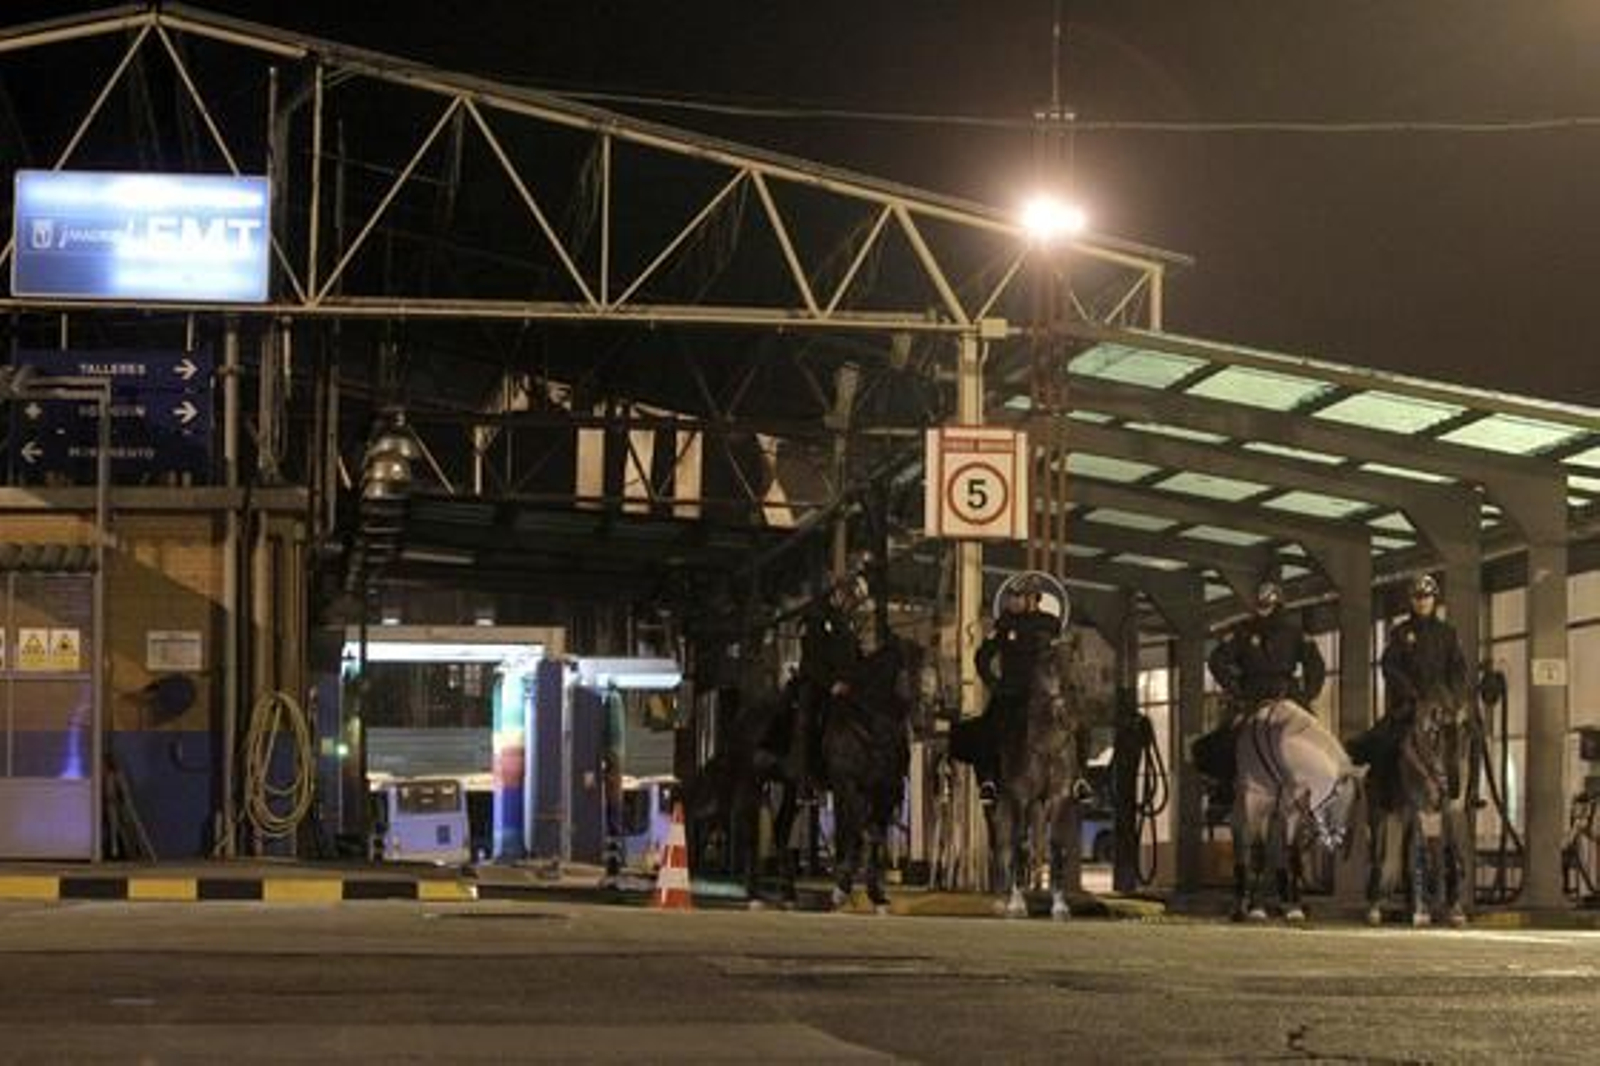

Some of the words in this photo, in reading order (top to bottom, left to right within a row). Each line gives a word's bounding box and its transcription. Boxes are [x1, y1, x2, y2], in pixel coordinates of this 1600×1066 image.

[148, 216, 260, 252] EMT
[80, 363, 146, 375] TALLERES
[967, 479, 988, 510] 5
